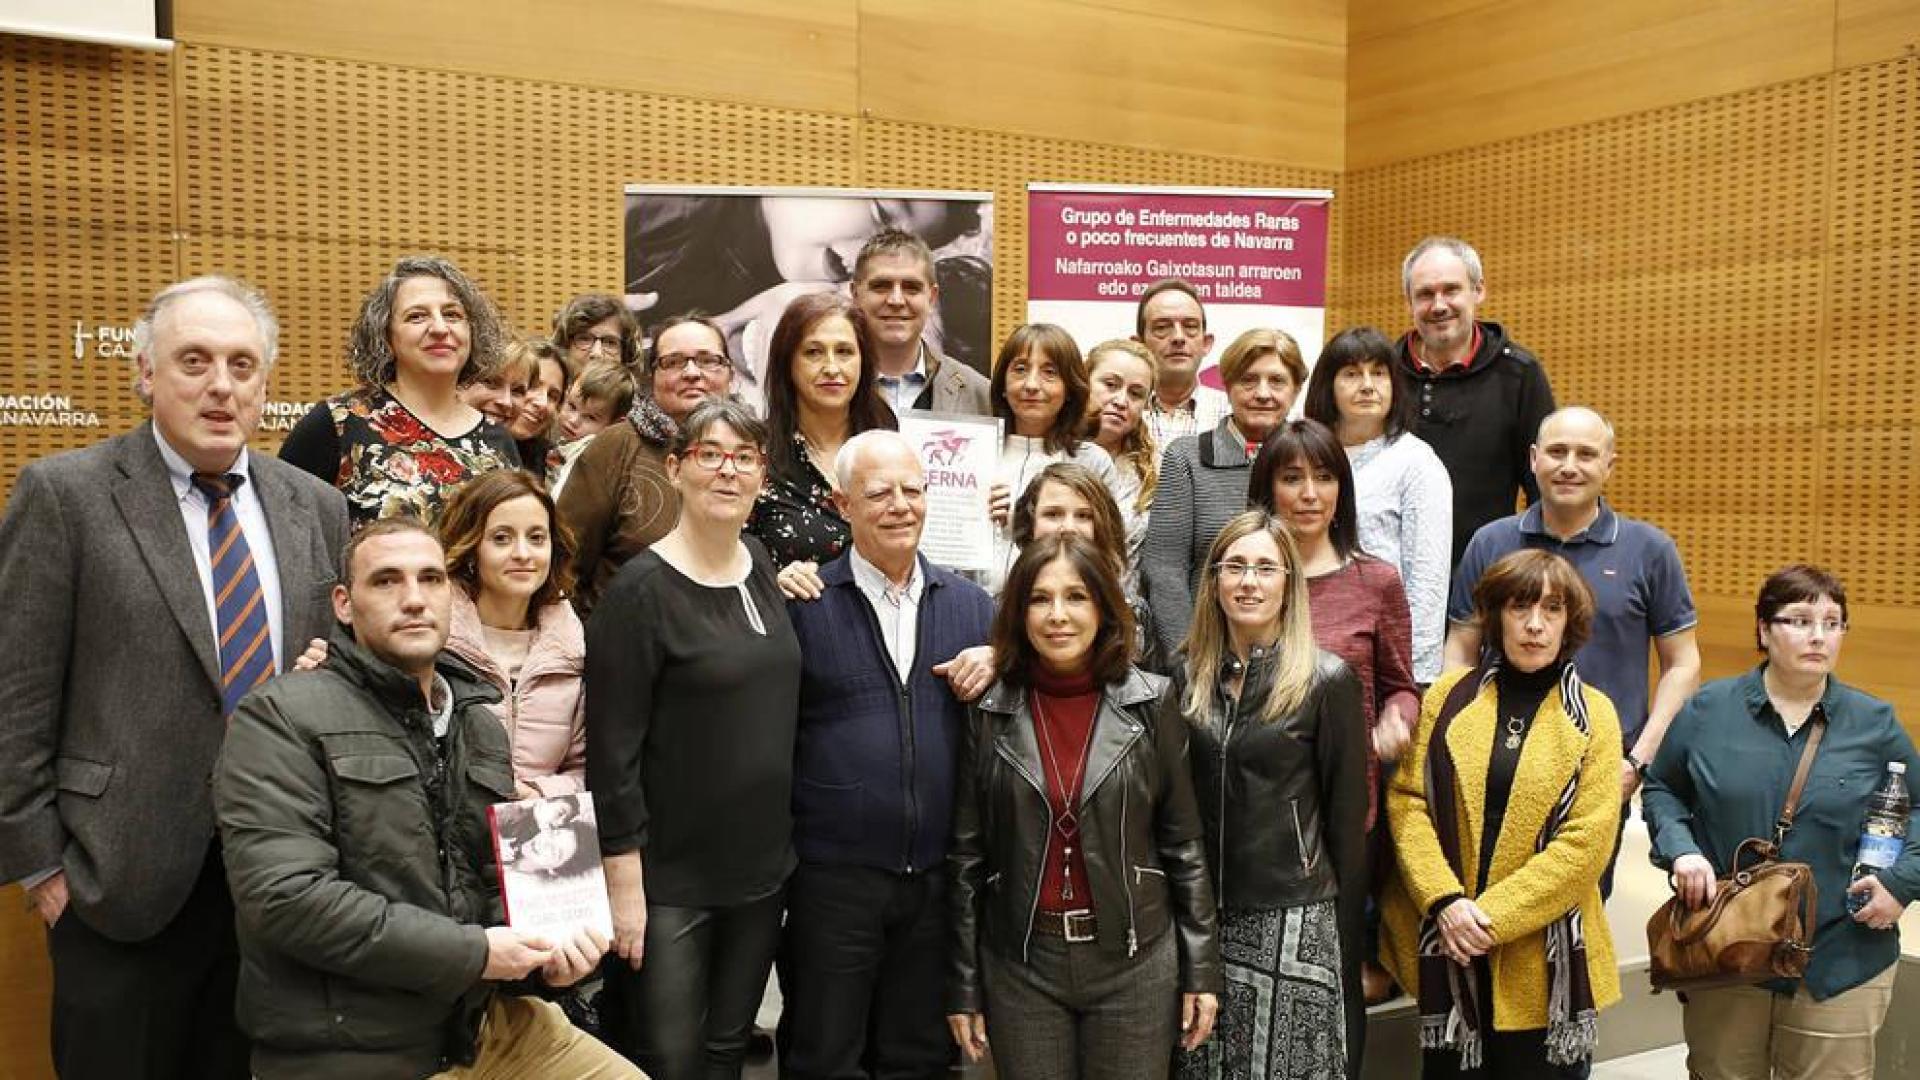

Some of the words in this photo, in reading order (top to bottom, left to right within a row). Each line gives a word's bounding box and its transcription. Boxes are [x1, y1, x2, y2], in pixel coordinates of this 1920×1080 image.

[1061, 207, 1112, 229] Grupo
[1115, 209, 1135, 226] de
[1139, 208, 1251, 229] Enfermedades
[1254, 211, 1300, 230] Raras
[1066, 230, 1077, 245] o
[1081, 231, 1121, 249] poco
[1124, 228, 1207, 248] frecuentes
[1210, 231, 1231, 248] de
[1234, 231, 1294, 251] Navarra
[1056, 257, 1143, 275] Nafarroako
[1146, 259, 1235, 278] Gaixotasun
[1238, 264, 1302, 280] arraroen
[1098, 279, 1128, 296] edo
[1215, 281, 1262, 299] taldea
[0, 410, 100, 427] NAVARRA
